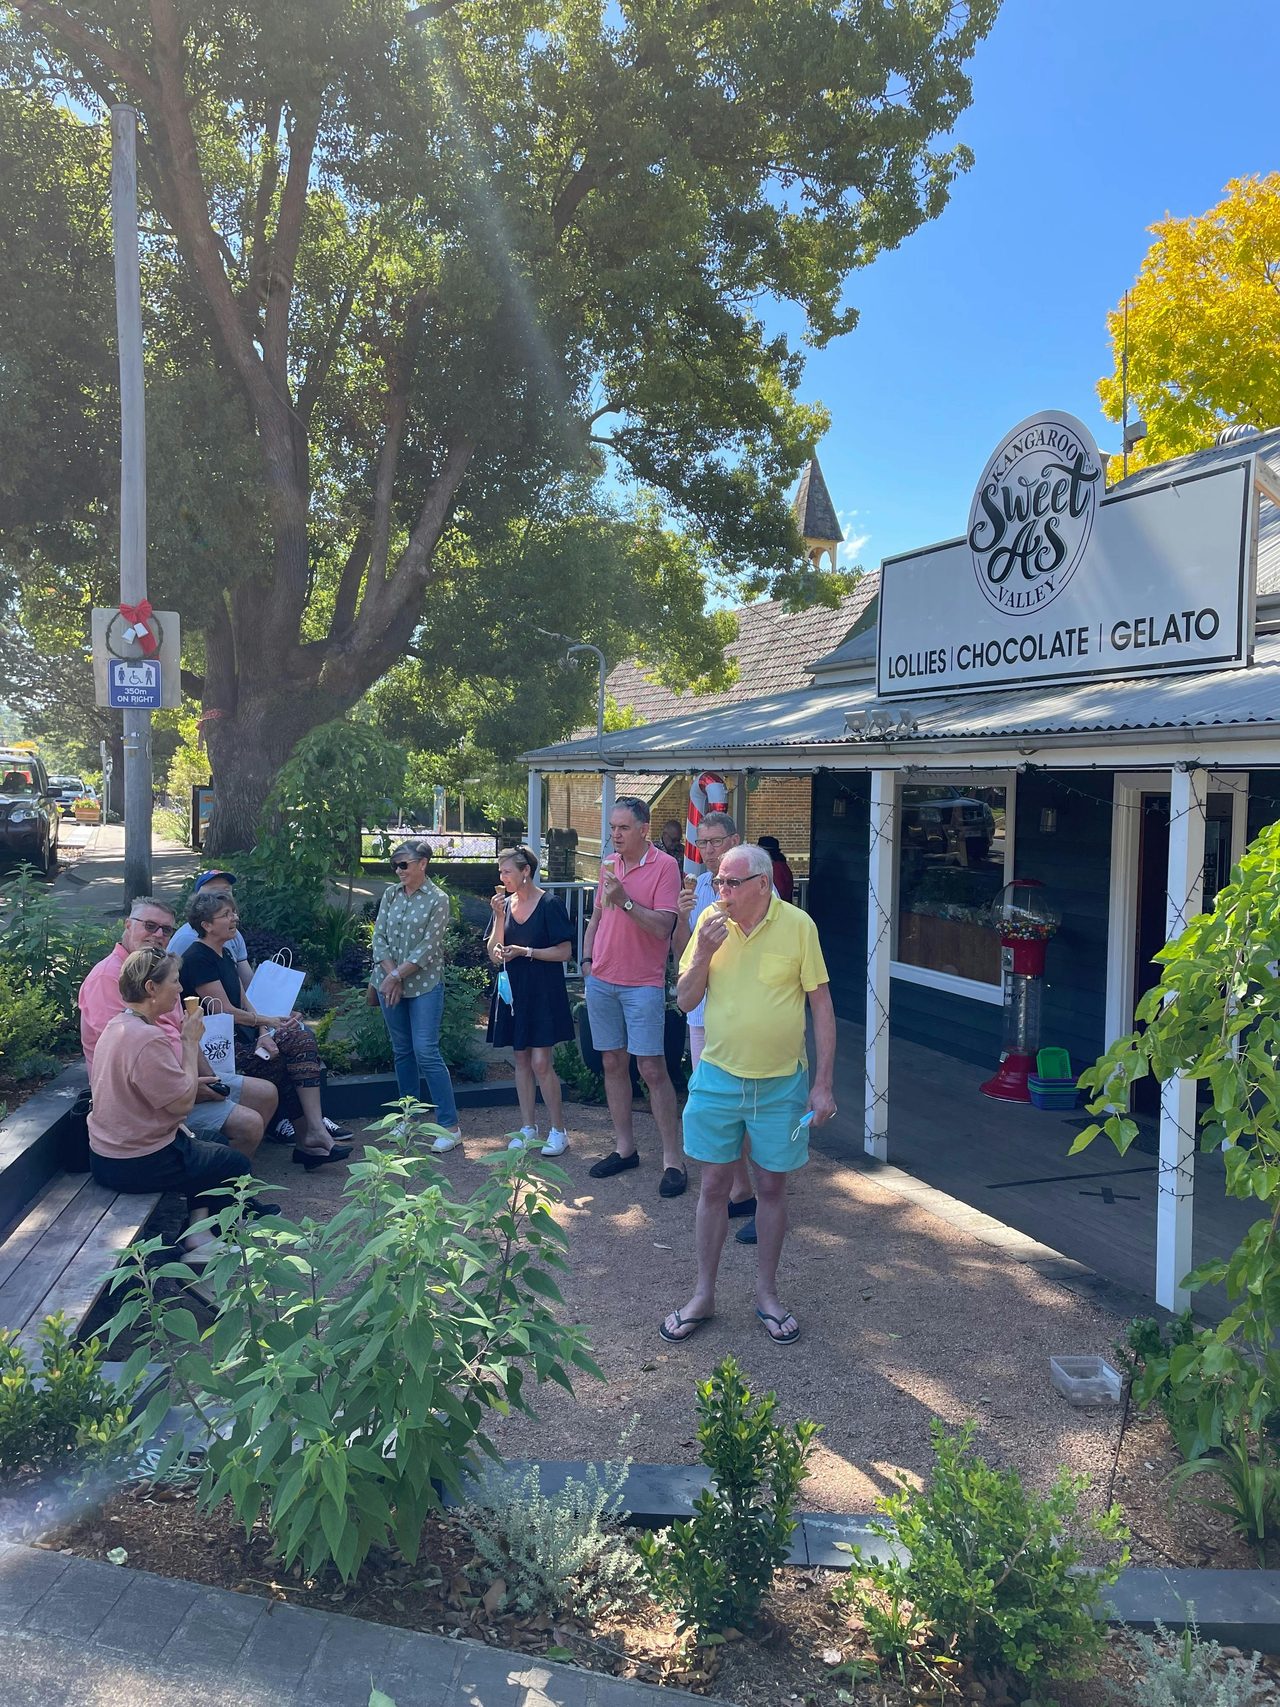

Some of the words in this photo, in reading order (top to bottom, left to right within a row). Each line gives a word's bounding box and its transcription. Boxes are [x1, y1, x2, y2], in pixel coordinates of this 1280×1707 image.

[992, 429, 1079, 483] KANGAROO
[969, 452, 1099, 553] Sweet
[998, 574, 1056, 608] VALLEY
[888, 648, 947, 679] LOLLIES
[957, 626, 1090, 670] CHOCOLATE
[1110, 607, 1220, 651] GELATO
[117, 695, 129, 703] ON
[131, 695, 154, 703] RIGHT
